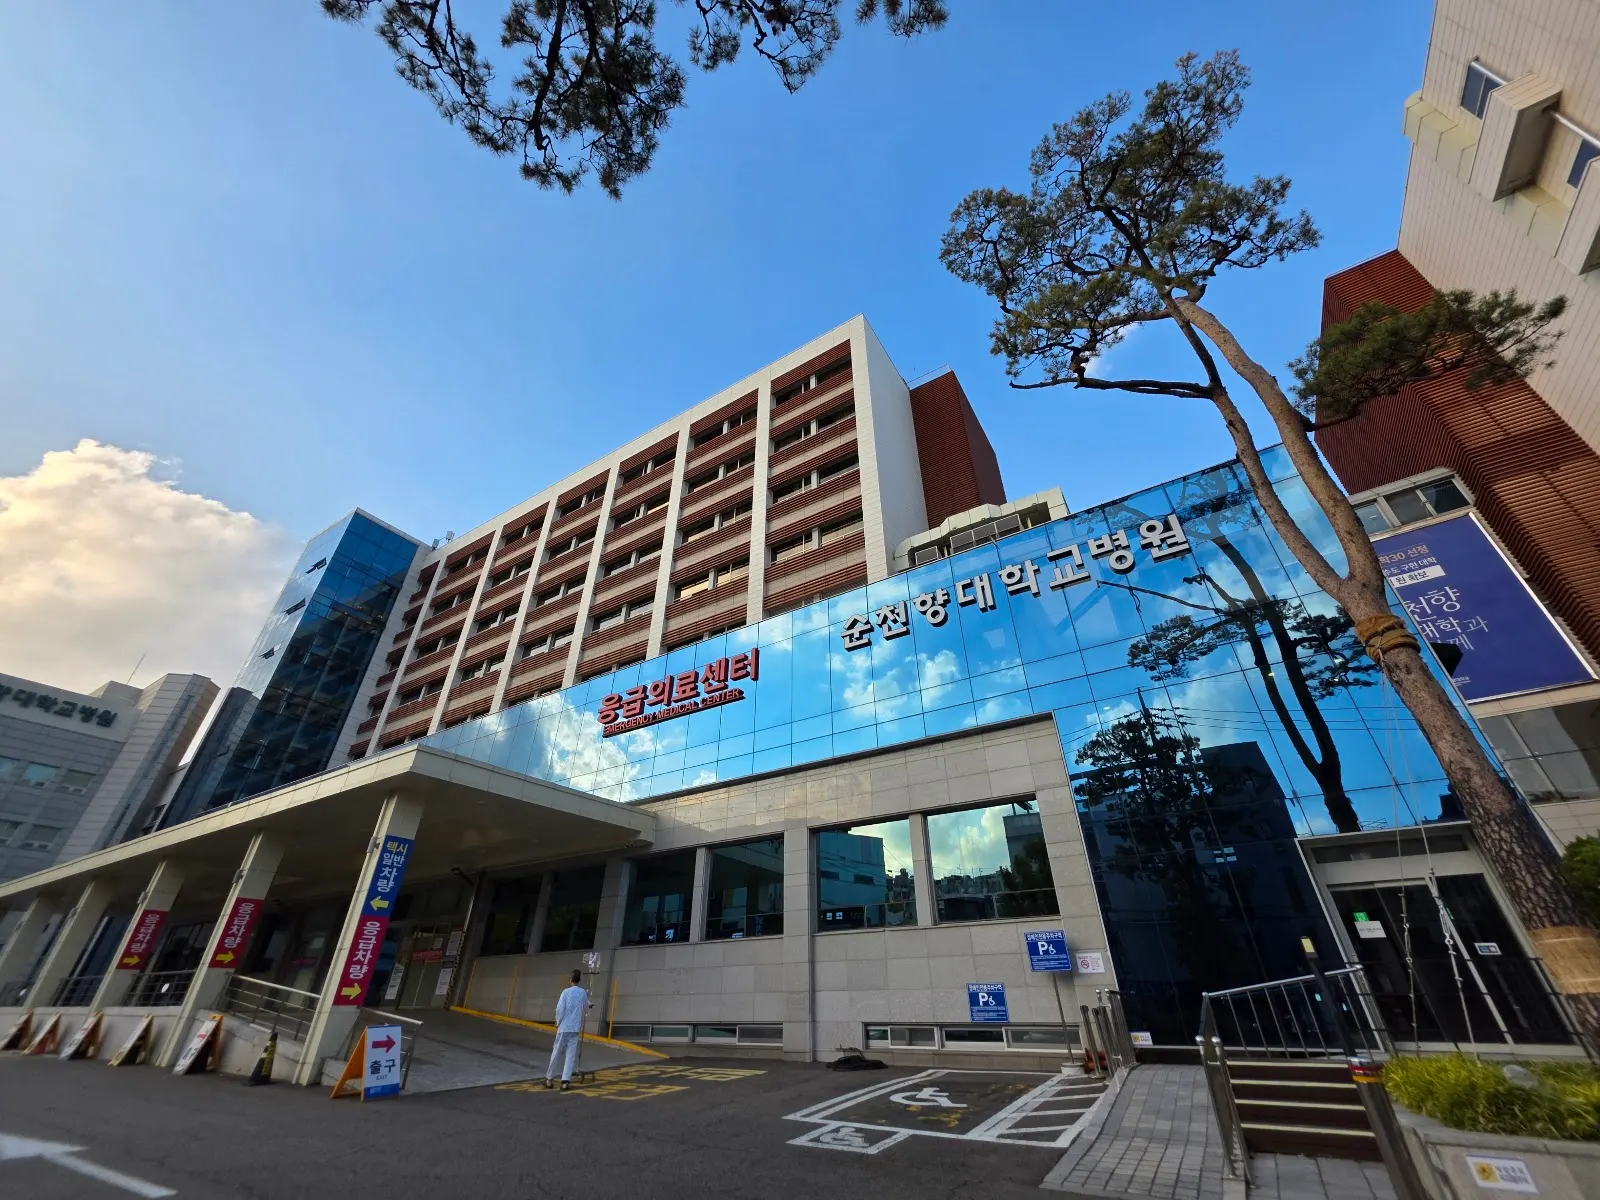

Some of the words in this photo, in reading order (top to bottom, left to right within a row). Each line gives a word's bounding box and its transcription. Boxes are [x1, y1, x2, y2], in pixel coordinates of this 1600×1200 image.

[1408, 544, 1429, 557] 선정
[1419, 556, 1437, 566] 대학
[840, 514, 1191, 651] 순천향대학교병원
[1409, 570, 1429, 581] 확보
[597, 647, 760, 725] 응급의료센터
[602, 713, 656, 737] EMERGENCY
[655, 702, 699, 720] MEDICAL
[699, 688, 743, 708] CENTER
[383, 852, 405, 867] 일반
[386, 841, 409, 856] 택시
[377, 867, 398, 893] 차량
[131, 913, 161, 953] 응급차량
[224, 902, 254, 949] 응급차량
[349, 921, 380, 979] 응급차량
[369, 1058, 397, 1075] 출구
